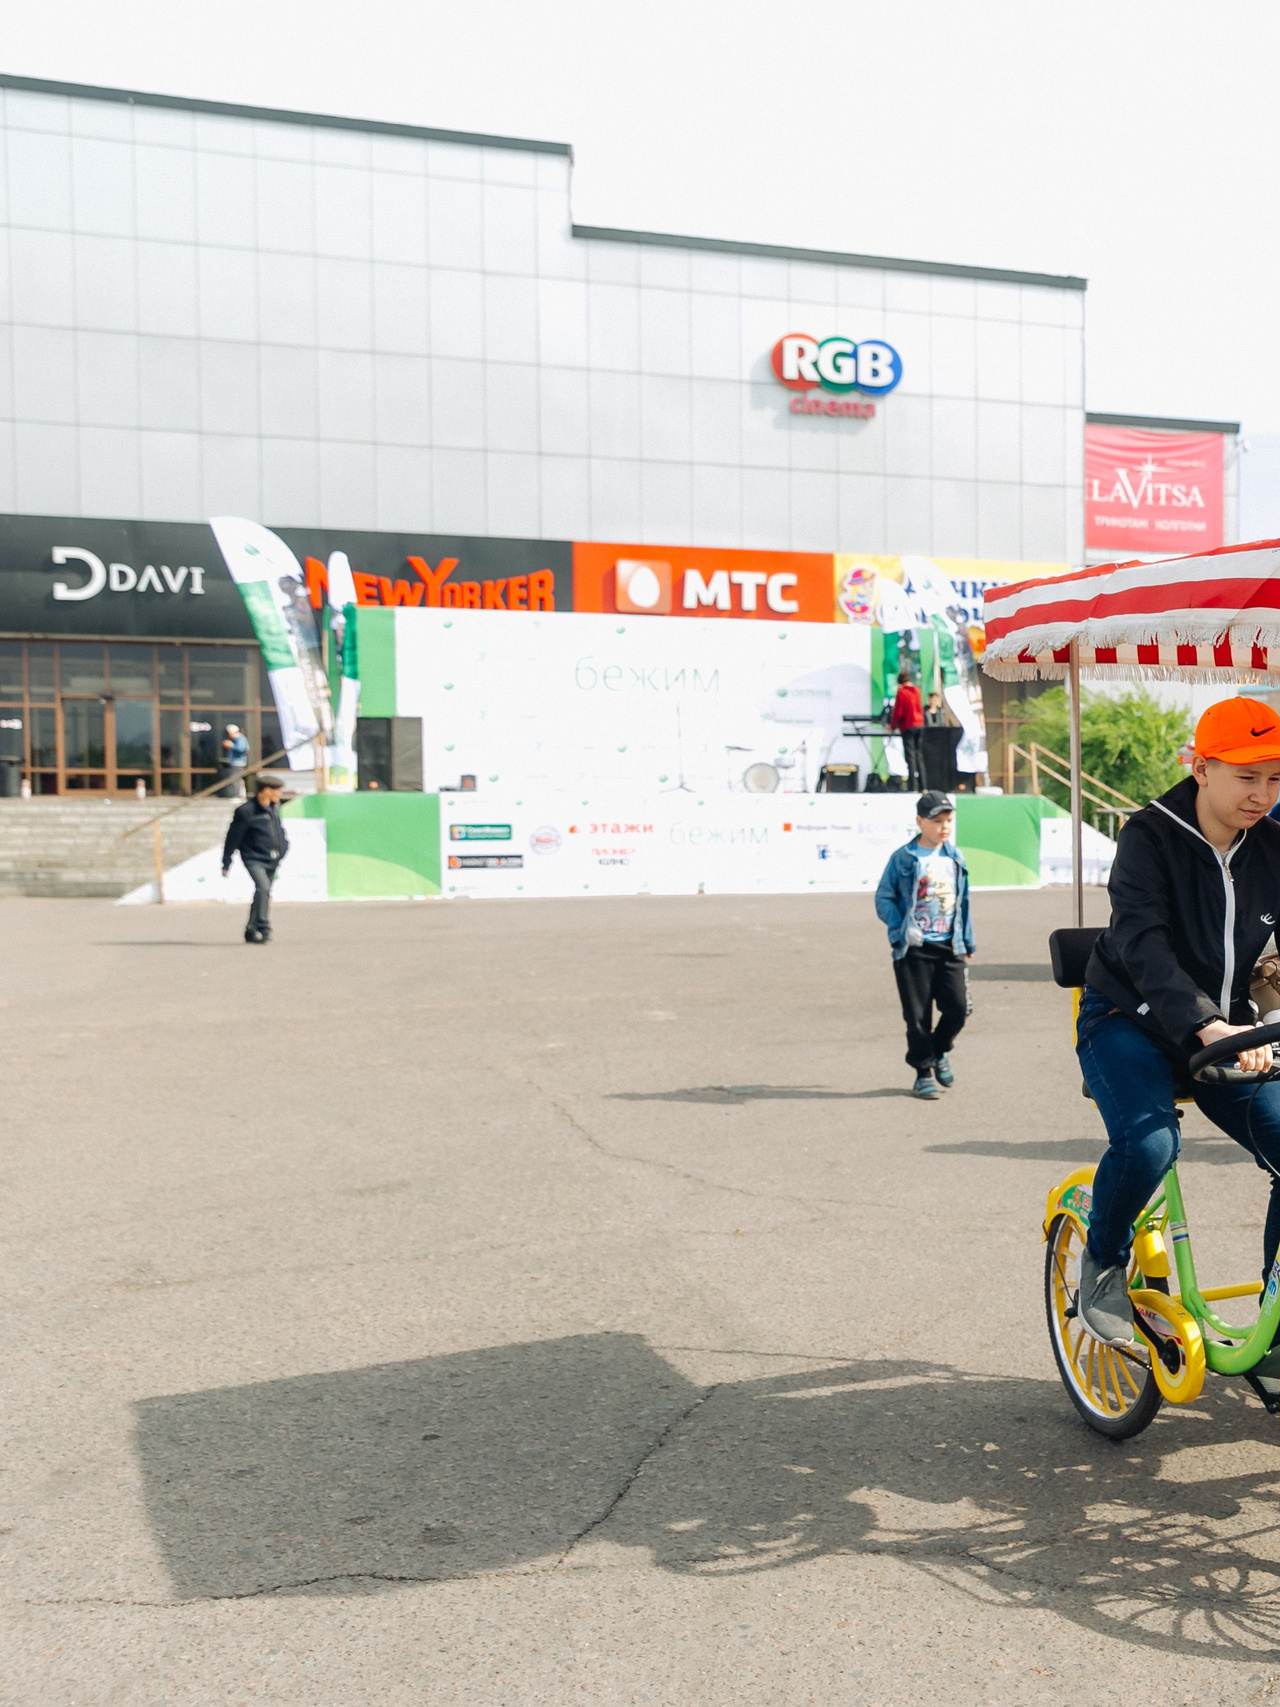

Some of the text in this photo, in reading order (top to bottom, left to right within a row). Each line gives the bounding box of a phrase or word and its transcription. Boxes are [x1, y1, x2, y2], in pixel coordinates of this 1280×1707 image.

[782, 337, 895, 388] RGB
[790, 393, 876, 419] cinema
[108, 562, 206, 595] DAVI
[682, 568, 800, 614] МТС
[574, 654, 721, 693] бежим
[669, 821, 769, 845] бежим
